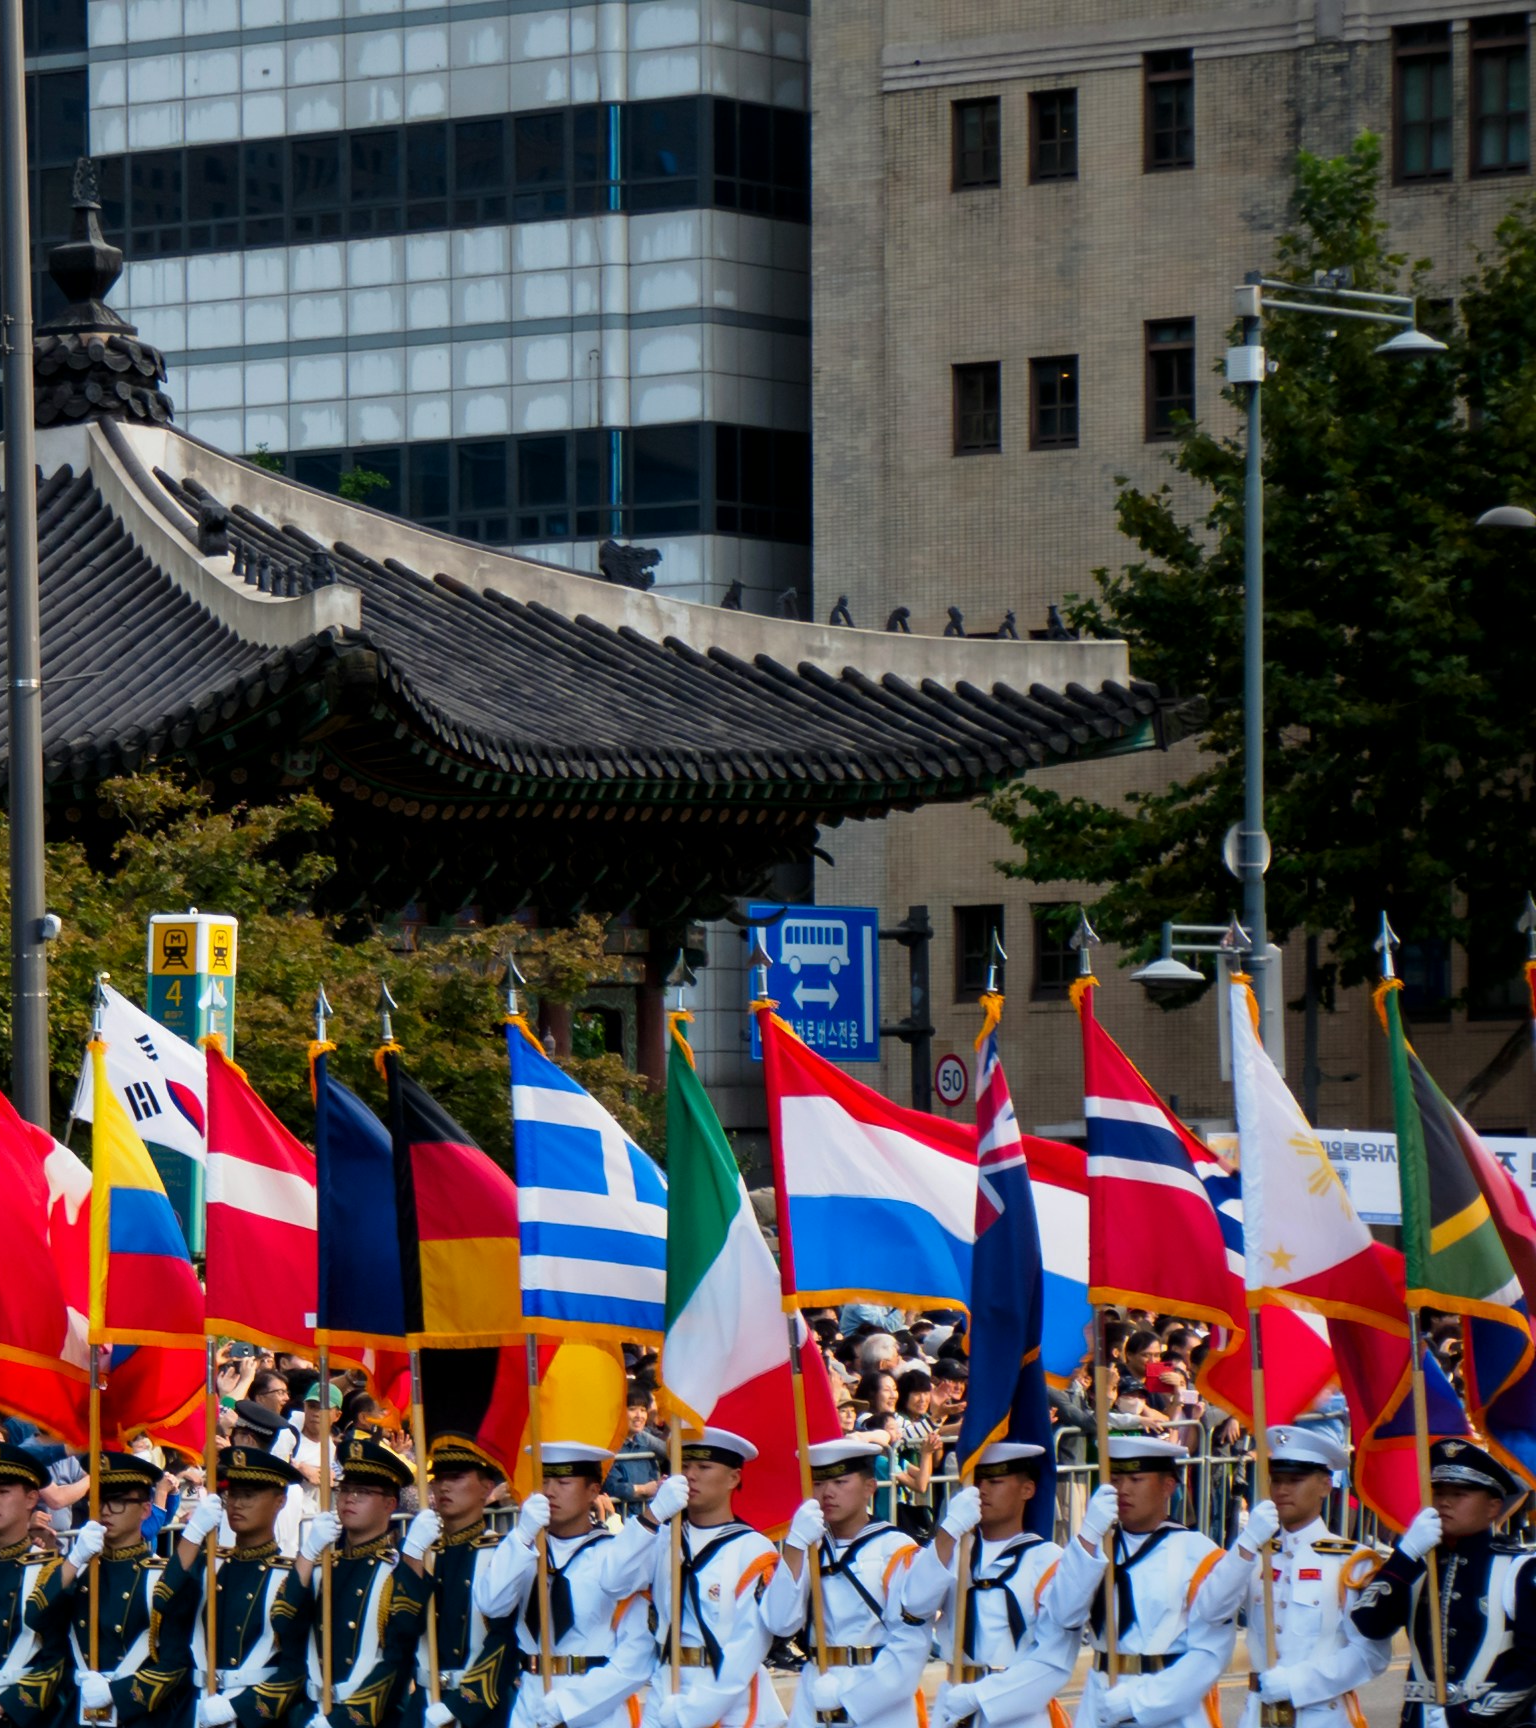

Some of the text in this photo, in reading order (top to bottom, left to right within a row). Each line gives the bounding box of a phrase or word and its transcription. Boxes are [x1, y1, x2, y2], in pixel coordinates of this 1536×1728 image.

[165, 979, 183, 1007] 4
[785, 1019, 859, 1049] 차로버스전용
[942, 1069, 963, 1092] 50
